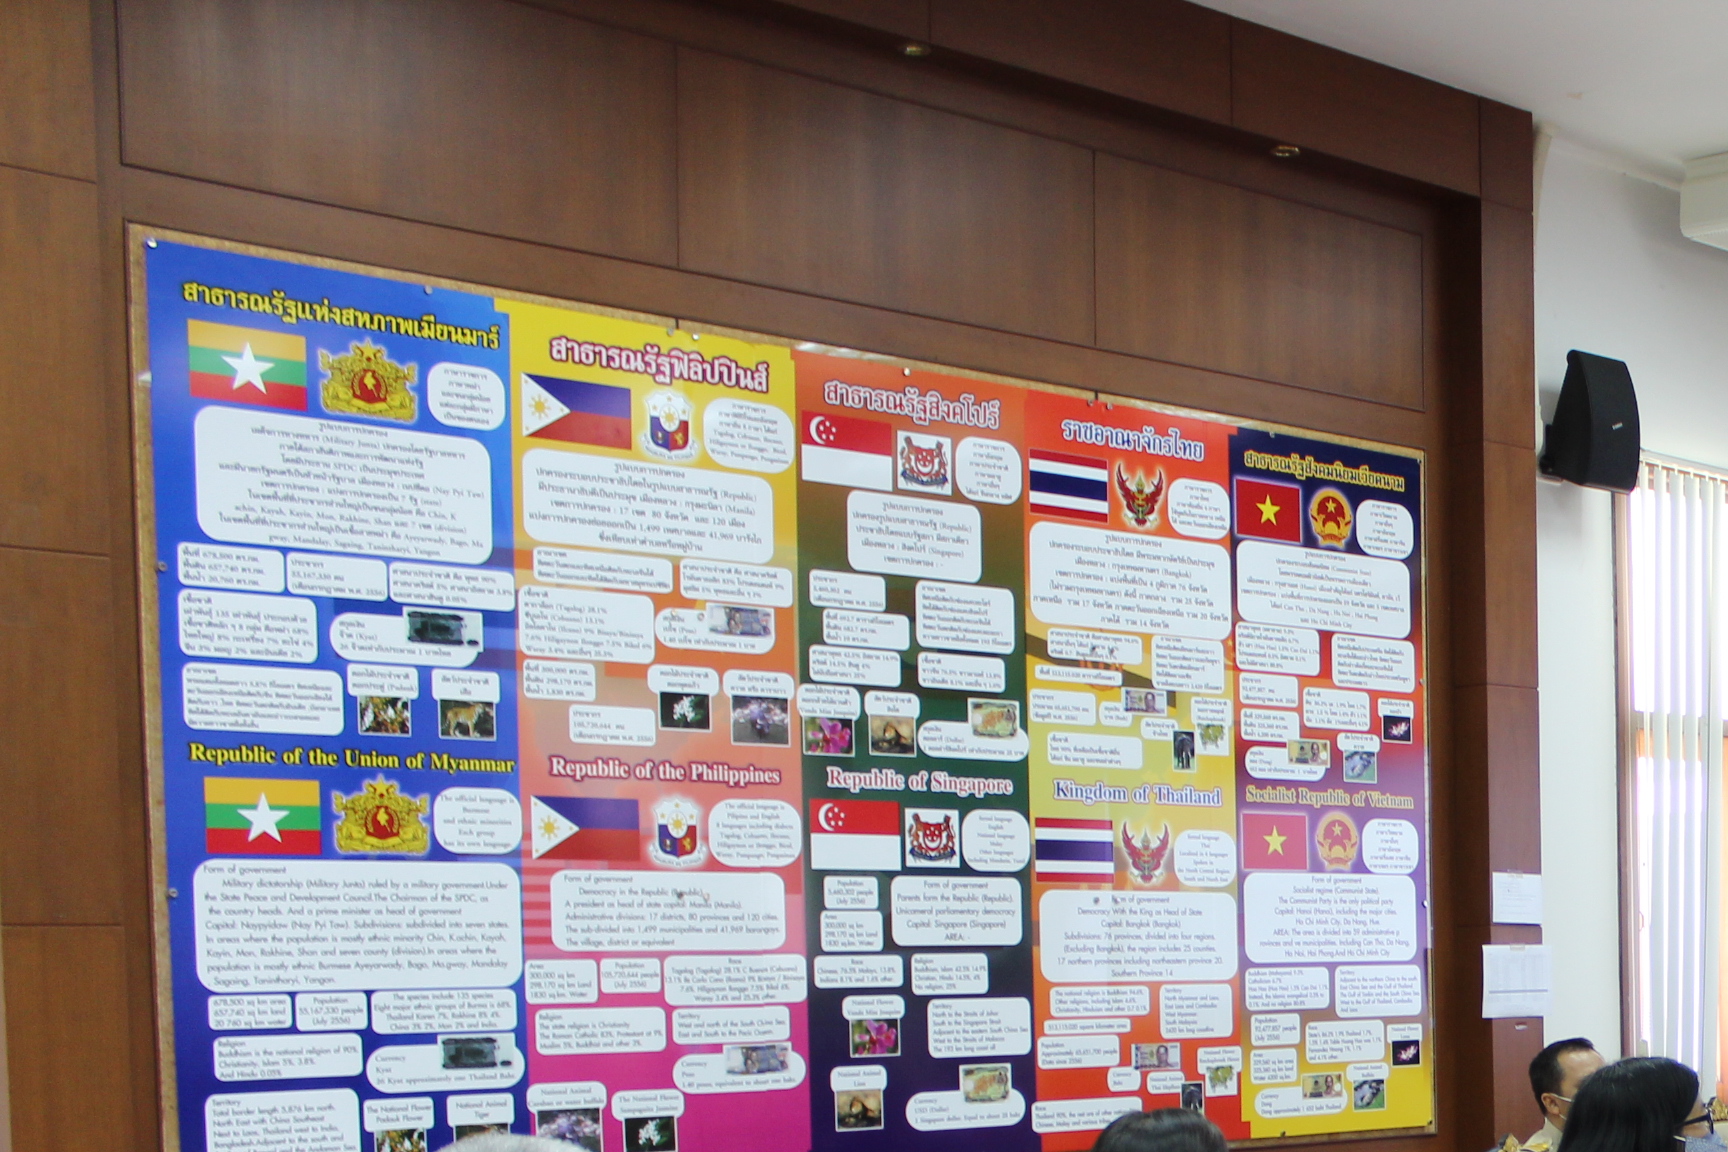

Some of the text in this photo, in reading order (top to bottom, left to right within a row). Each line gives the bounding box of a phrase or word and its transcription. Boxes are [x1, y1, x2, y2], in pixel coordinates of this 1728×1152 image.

[182, 278, 501, 351] สาธารณรัฐแห่งสหภาพเมียนมาร์
[550, 336, 769, 393] สาธารณรัฐฟิลิปปินส์
[824, 379, 1000, 429] สาธารณรัฐสิงคโปร์
[1061, 419, 1204, 462] ราชอาณาจักรไทย
[1244, 450, 1405, 492] สาธารณรัฐสังคมนิยมเวียดนาม
[188, 743, 516, 774] Republic of the Union of Myanmar
[549, 756, 781, 787] Republic of the Philippines
[826, 766, 1013, 798] Republic of Singapore
[1053, 779, 1223, 807] Kingdom of Thailand
[1246, 785, 1414, 809] Socialist Republic of Vietnam
